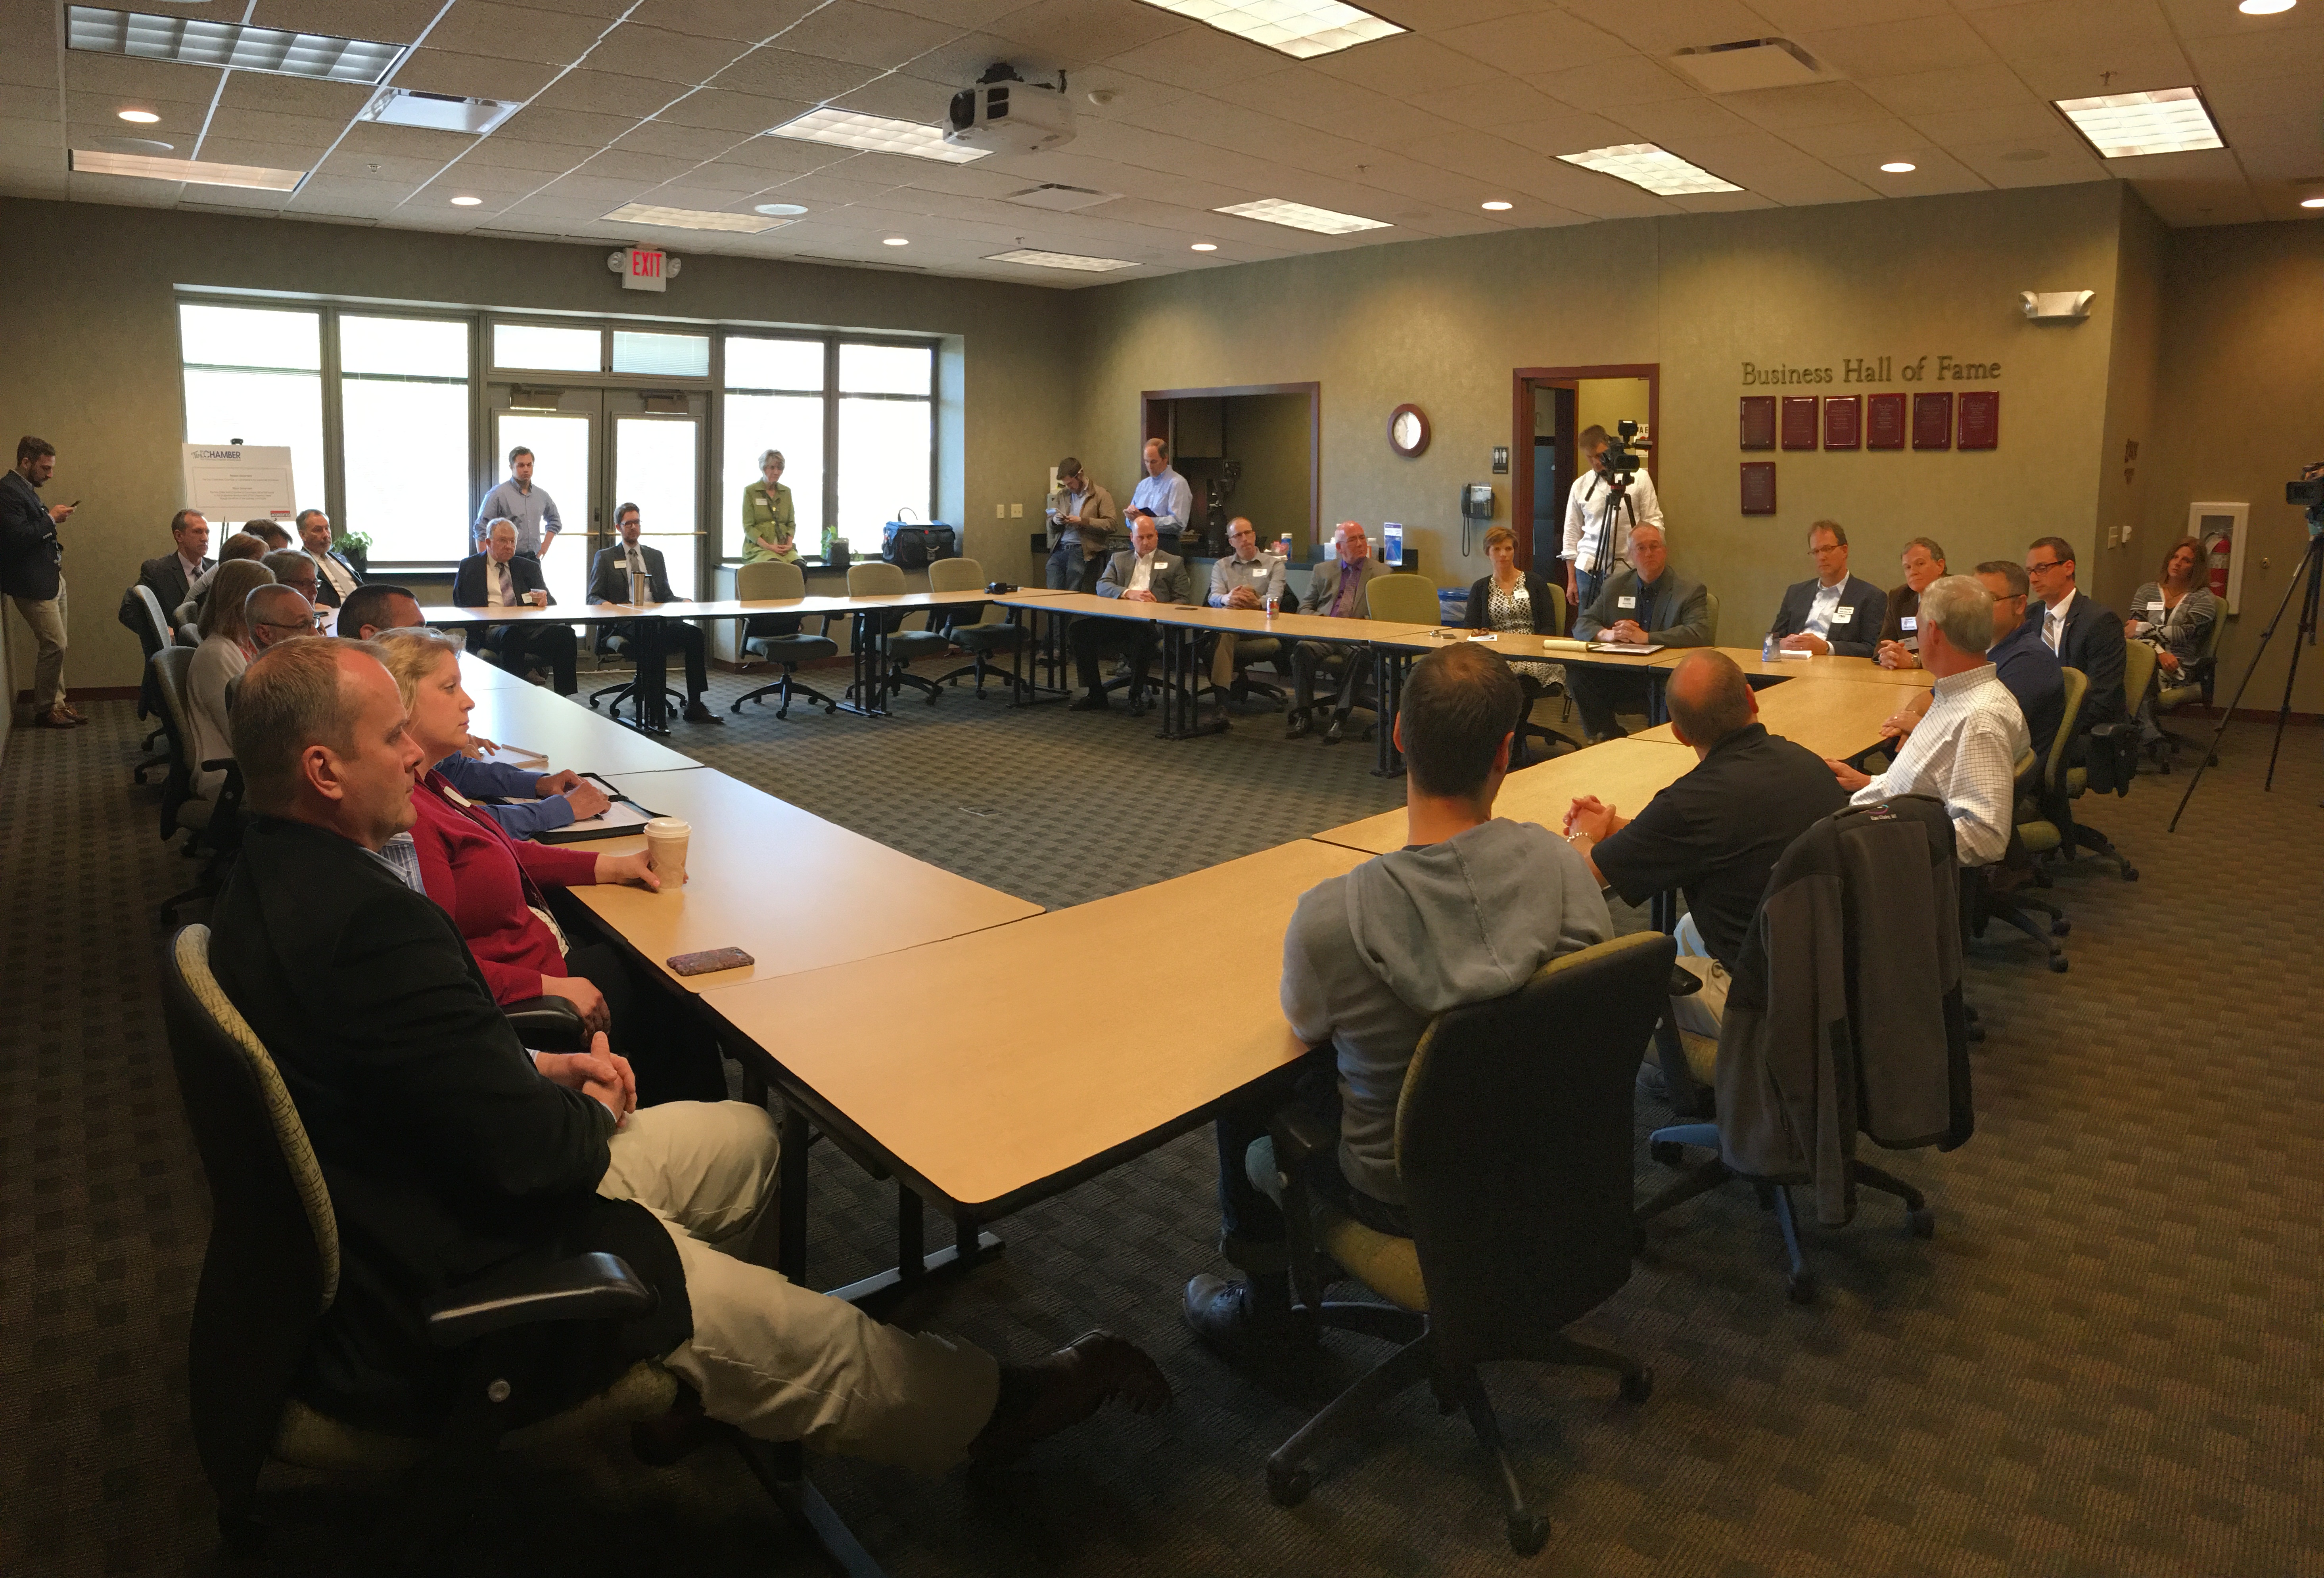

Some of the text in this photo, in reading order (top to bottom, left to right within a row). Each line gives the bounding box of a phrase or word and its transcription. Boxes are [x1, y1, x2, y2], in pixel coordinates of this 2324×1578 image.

[633, 251, 662, 278] EXIT
[1741, 355, 2002, 385] Business Hall of Fame
